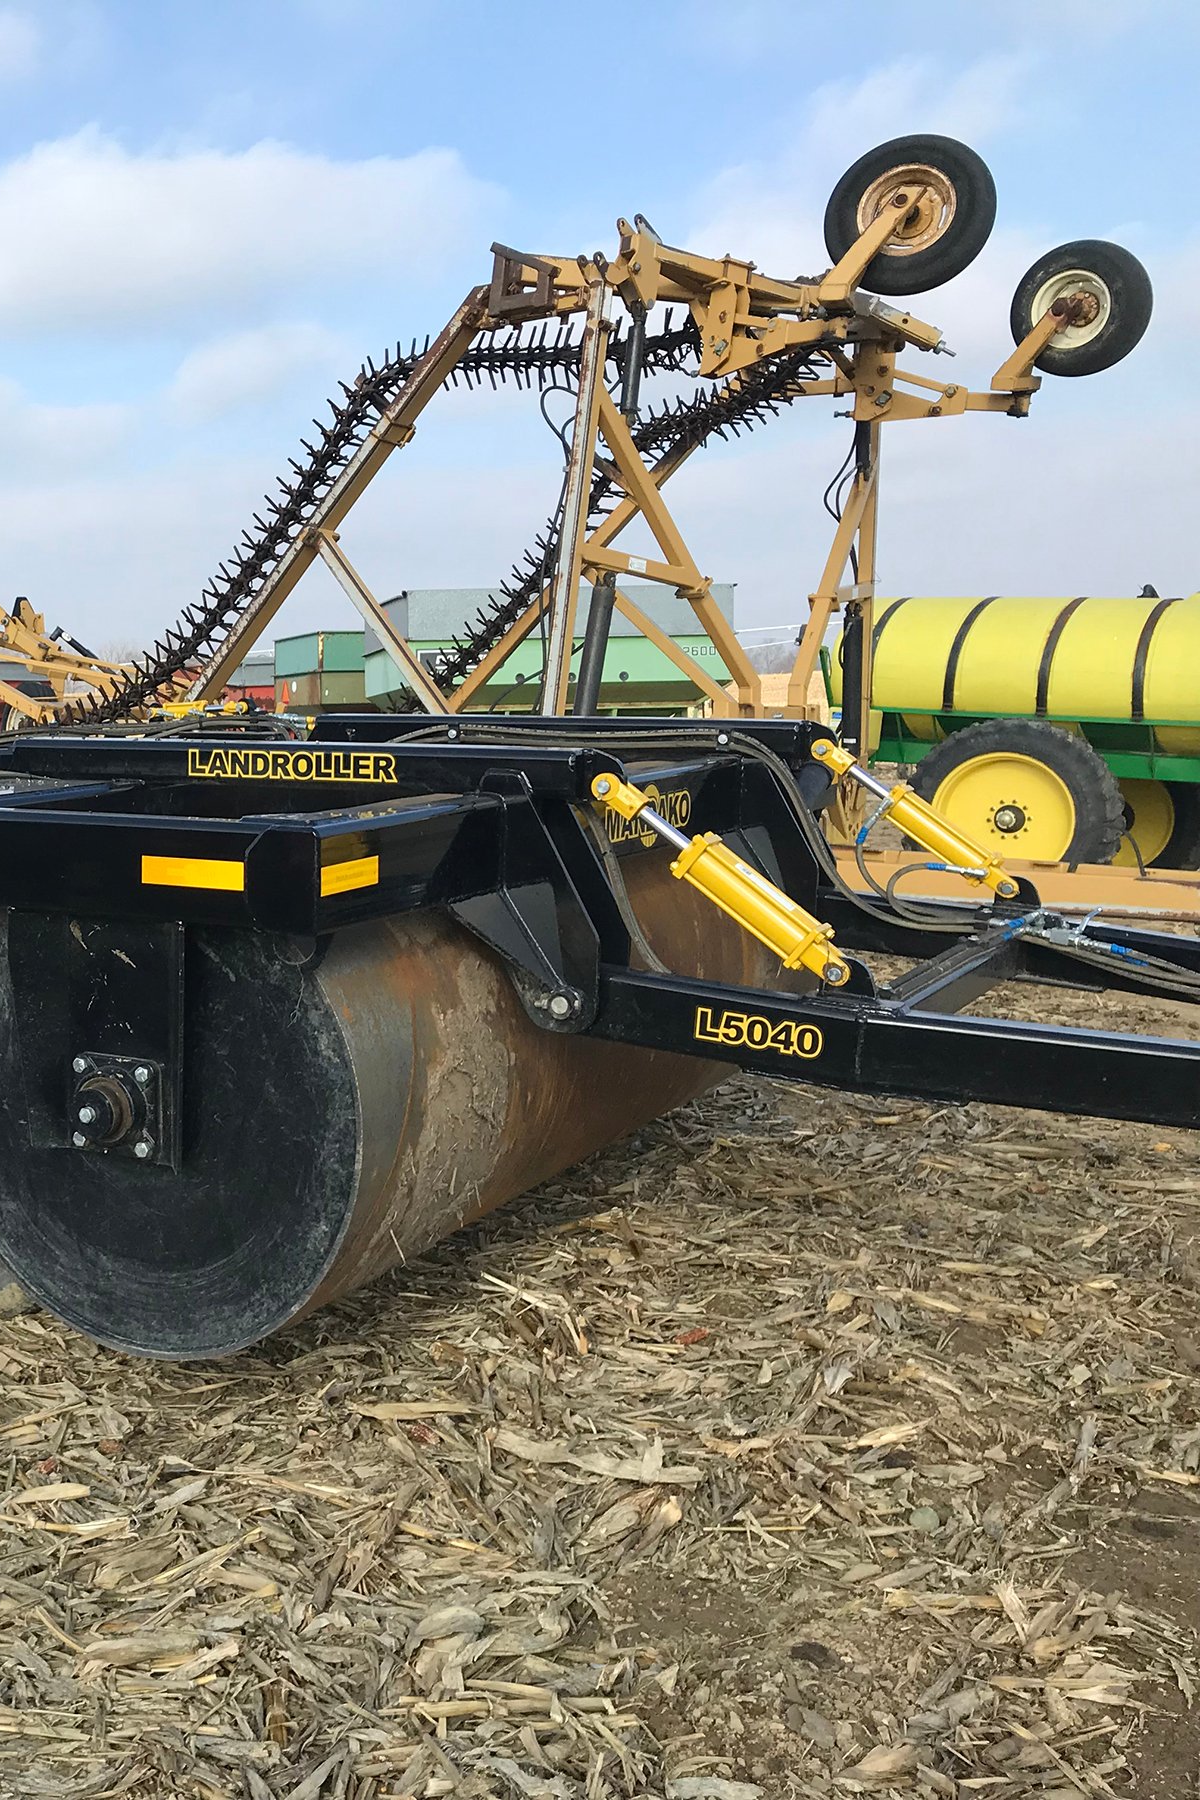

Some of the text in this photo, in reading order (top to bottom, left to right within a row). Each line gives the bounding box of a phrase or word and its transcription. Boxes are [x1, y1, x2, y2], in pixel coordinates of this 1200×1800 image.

[682, 645, 717, 656] 2600
[188, 749, 398, 783] LANDROLLER
[695, 1007, 823, 1058] L5040
